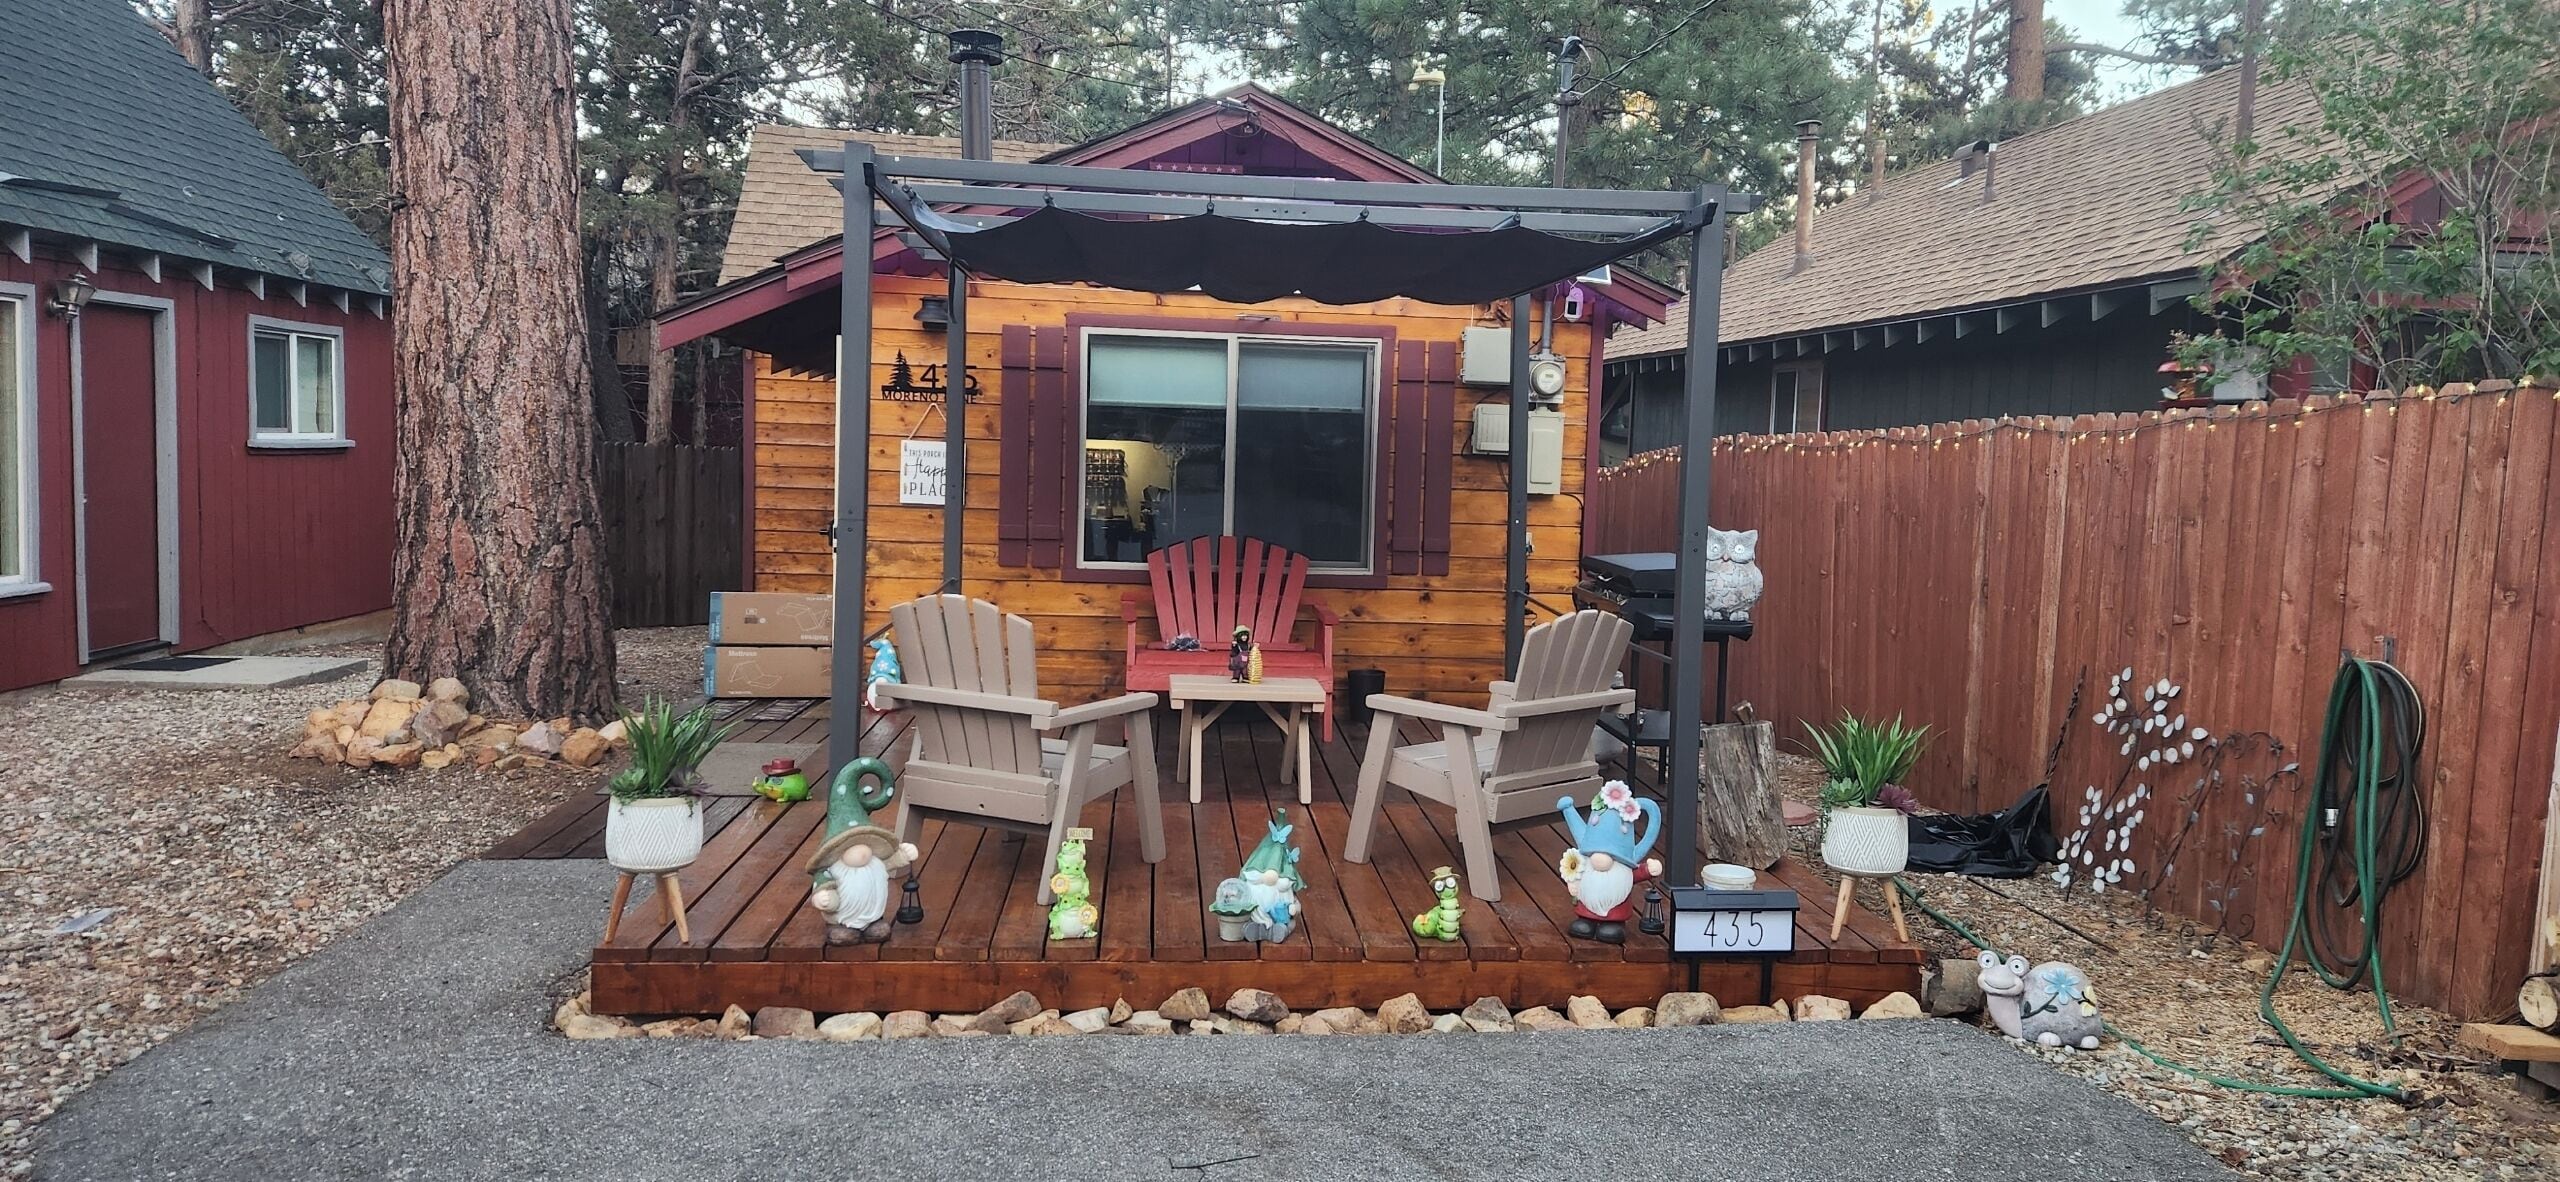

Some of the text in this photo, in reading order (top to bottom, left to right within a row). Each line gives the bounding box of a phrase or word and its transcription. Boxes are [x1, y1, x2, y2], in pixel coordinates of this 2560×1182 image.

[919, 363, 978, 390] 45
[882, 390, 939, 403] MORENO
[909, 449, 921, 457] THIS
[923, 450, 941, 458] PORCH
[906, 457, 947, 484] Happ
[909, 482, 947, 497] PLAC
[1703, 911, 1764, 948] 435
